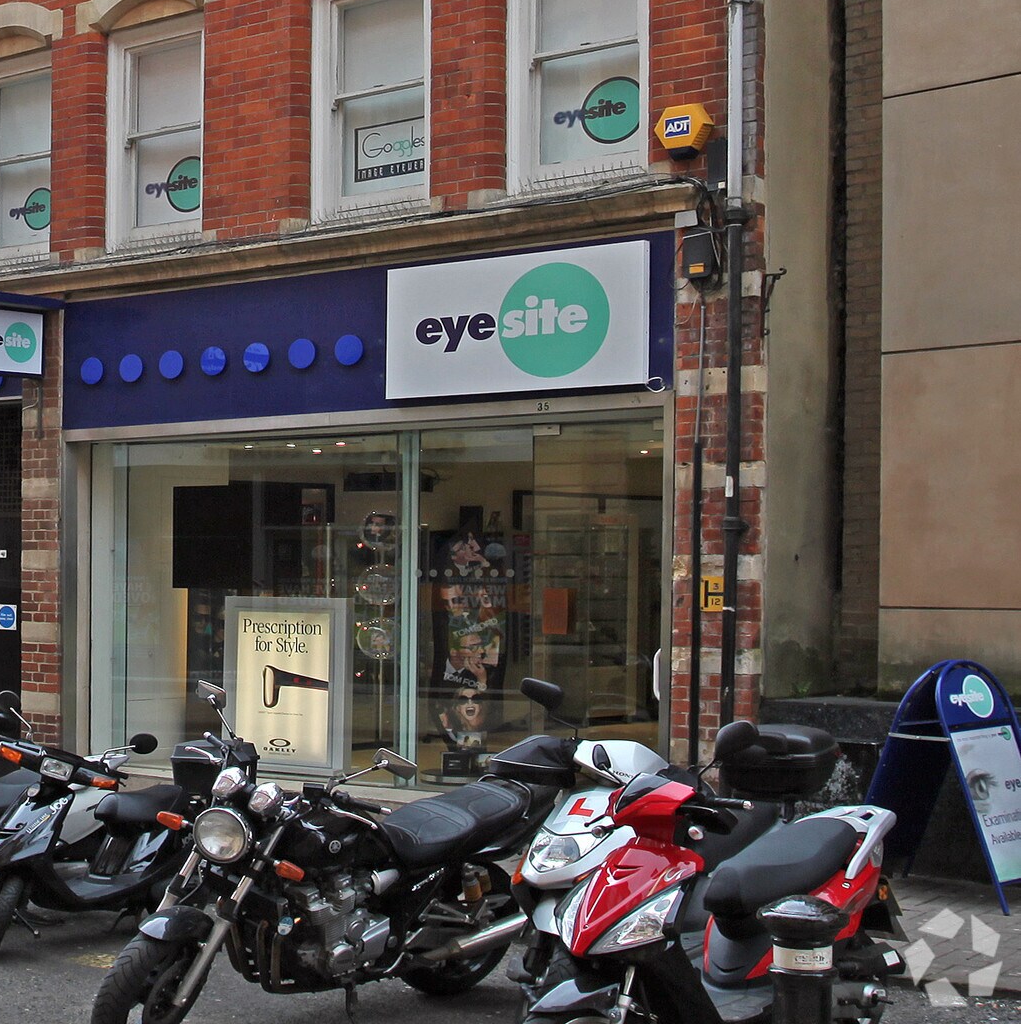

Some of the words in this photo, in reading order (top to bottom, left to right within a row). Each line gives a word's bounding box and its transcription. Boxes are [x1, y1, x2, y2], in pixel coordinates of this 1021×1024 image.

[553, 98, 627, 128] eyesite
[664, 119, 690, 135] ADT
[362, 125, 425, 159] Goggles
[357, 166, 384, 180] IMAGE
[390, 159, 424, 175] EYEWEA
[144, 174, 199, 199] eyesite
[9, 201, 46, 220] eyesite
[415, 295, 589, 353] eyesite
[537, 402, 550, 412] 35
[713, 582, 720, 591] 3
[711, 597, 721, 606] 12
[242, 618, 323, 638] Prescription
[254, 636, 273, 652] for
[275, 637, 309, 657] Style.
[443, 672, 463, 683] TOM
[462, 678, 488, 692] FORD
[949, 689, 985, 707] eyesite
[49, 796, 69, 815] JOG
[567, 797, 595, 818] L
